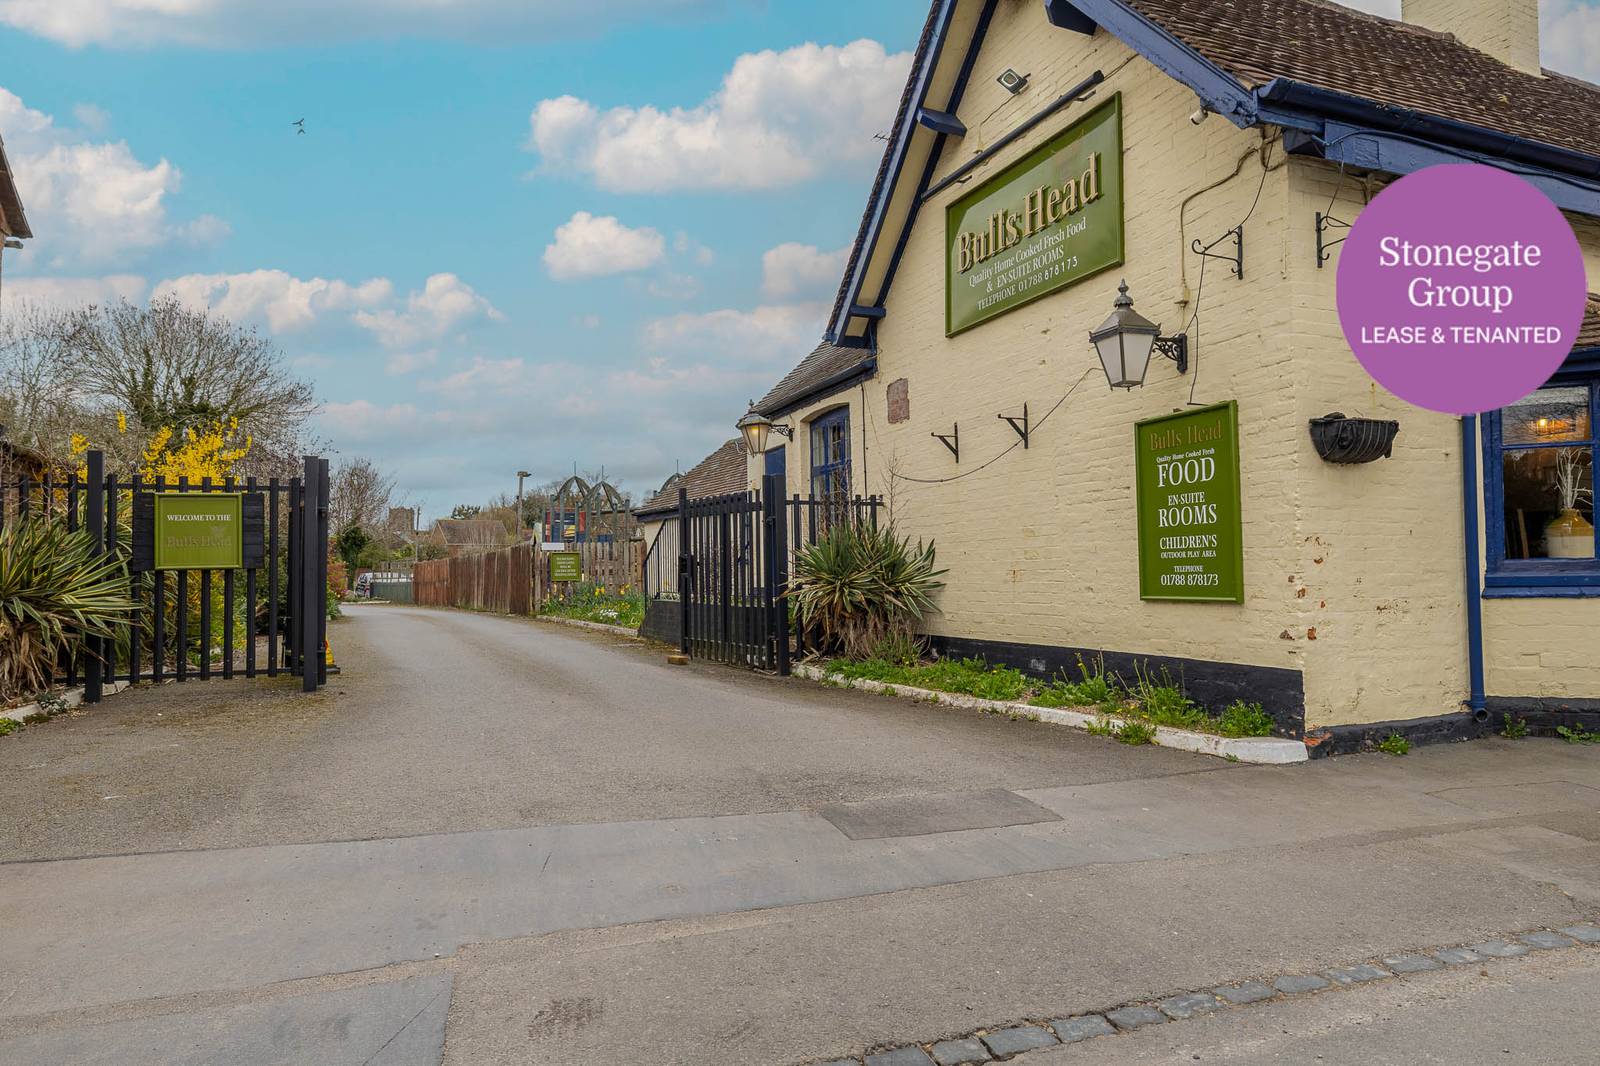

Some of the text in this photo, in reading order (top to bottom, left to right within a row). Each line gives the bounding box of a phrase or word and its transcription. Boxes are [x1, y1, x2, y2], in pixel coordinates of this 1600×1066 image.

[956, 152, 1099, 273] Bulls Head
[969, 217, 1087, 288] Quality Home Cooked Fresh Food
[986, 245, 1065, 293] & EN-SUITE ROOMS
[977, 285, 1017, 310] TELEPHONE
[1018, 273, 1043, 292] 01788
[1150, 419, 1222, 450] Bulls Head
[1185, 450, 1202, 458] Cooked
[1157, 457, 1215, 487] FOOD
[1168, 491, 1205, 506] EN-SUITE
[1158, 503, 1217, 527] ROOMS
[1160, 534, 1217, 549] CHILDREN'S
[1160, 551, 1186, 559] OUTDOOR
[1187, 550, 1200, 558] PLAY
[1161, 573, 1219, 586] 01788 878173
